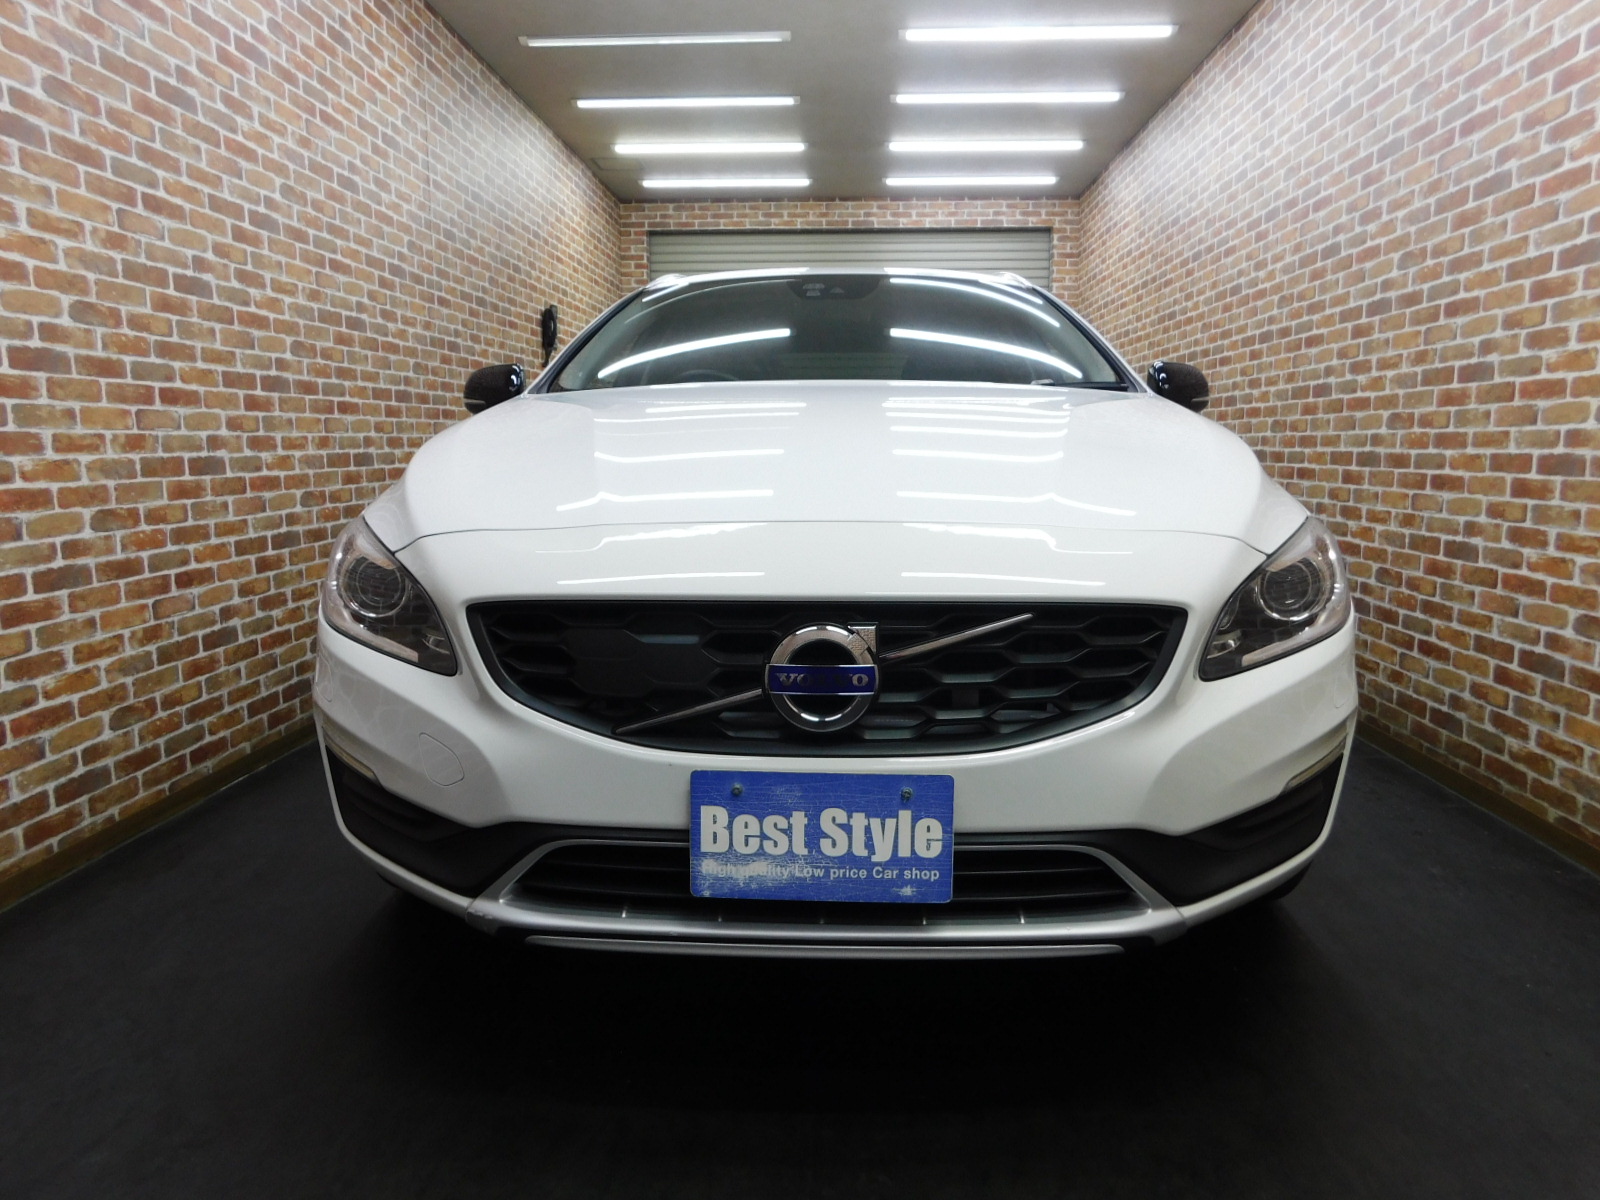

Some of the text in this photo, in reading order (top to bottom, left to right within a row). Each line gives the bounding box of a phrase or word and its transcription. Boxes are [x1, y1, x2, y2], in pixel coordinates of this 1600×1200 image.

[775, 673, 869, 687] VOO
[700, 805, 942, 862] Best Style
[794, 863, 825, 878] Low
[830, 866, 867, 879] price
[872, 866, 898, 880] Car
[903, 867, 940, 882] shop
